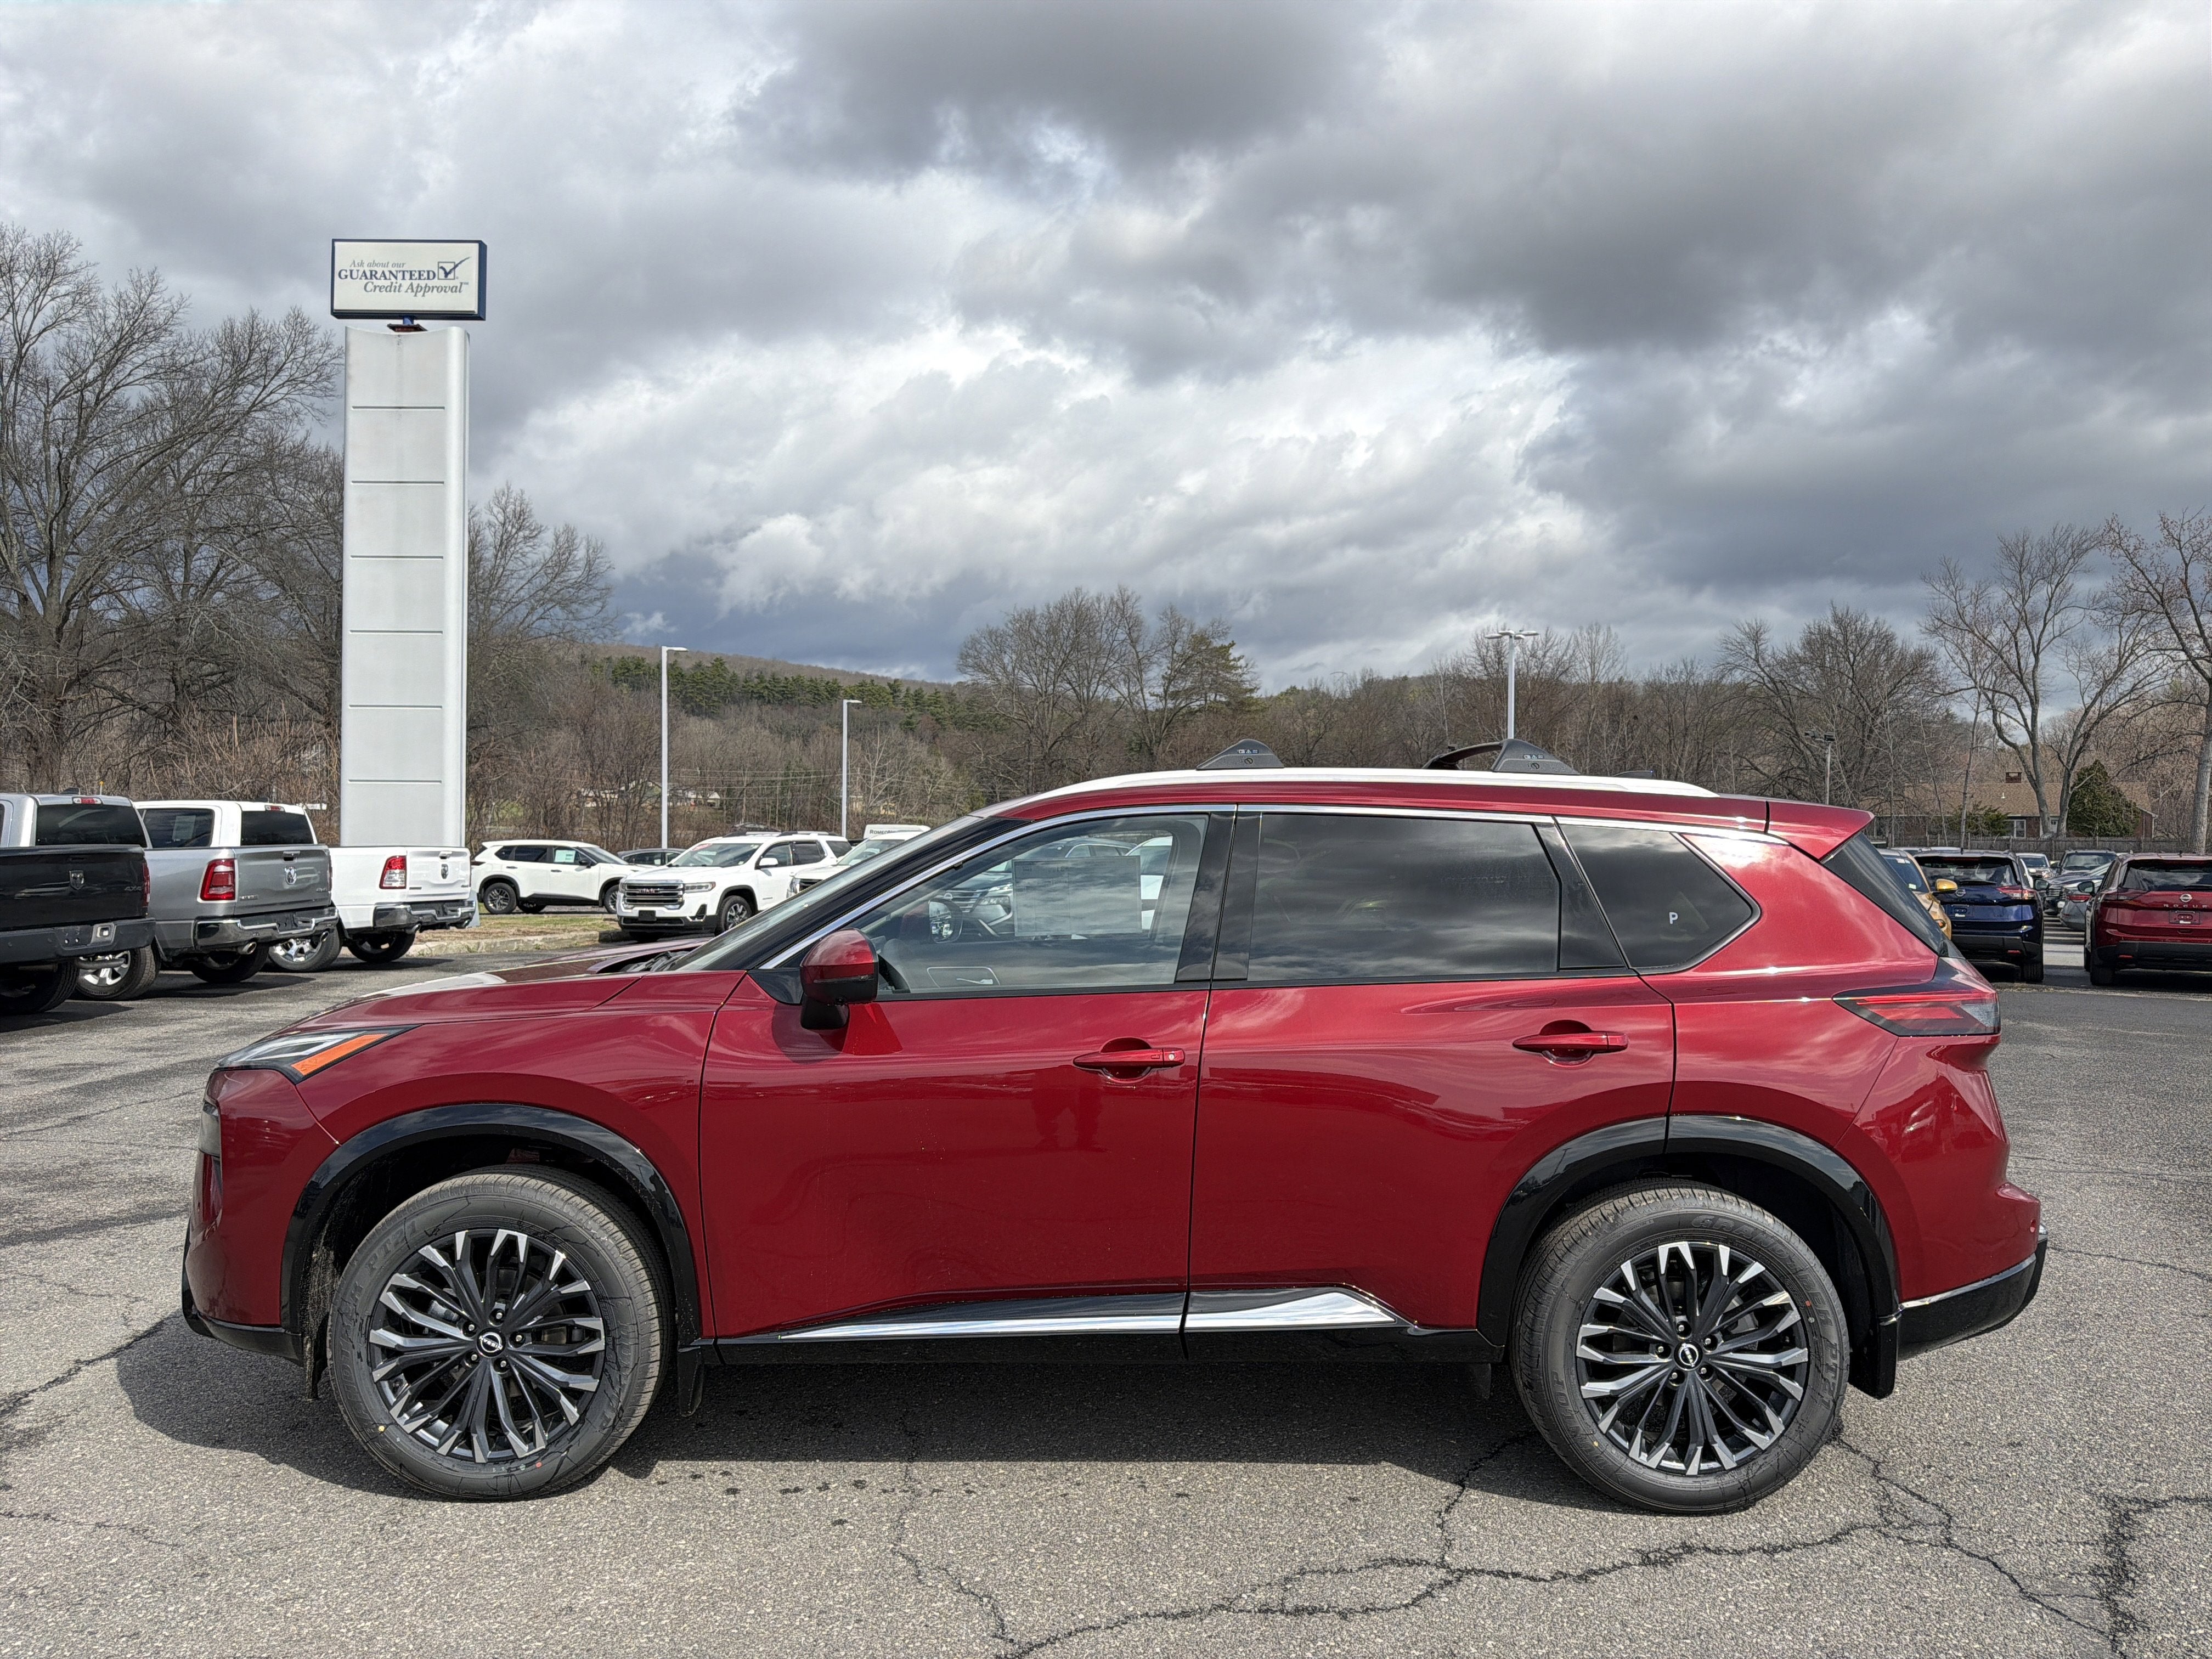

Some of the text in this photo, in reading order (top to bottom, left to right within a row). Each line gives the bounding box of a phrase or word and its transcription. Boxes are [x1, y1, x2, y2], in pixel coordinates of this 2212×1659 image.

[349, 259, 365, 268] Ask
[366, 260, 390, 268] about
[338, 269, 436, 281] GUARANTEED
[363, 281, 402, 293] Credit
[1669, 912, 1678, 924] P
